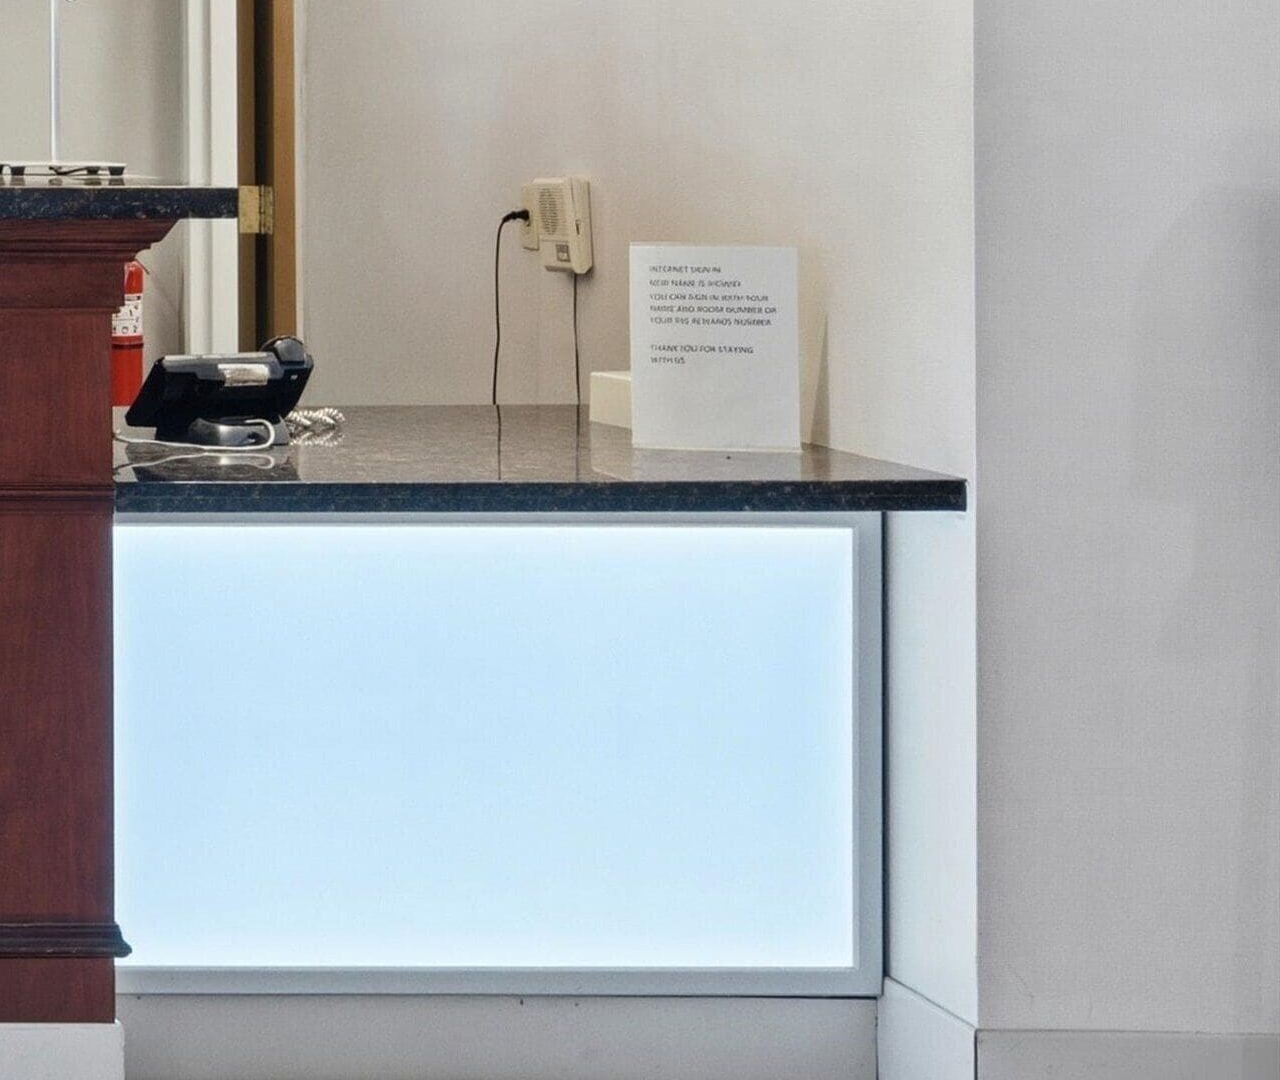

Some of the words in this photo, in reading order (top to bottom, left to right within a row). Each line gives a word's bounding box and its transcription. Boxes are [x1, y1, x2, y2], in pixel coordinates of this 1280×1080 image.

[649, 265, 688, 273] INTERNET
[649, 293, 668, 301] YOU
[668, 293, 687, 301] CAN
[725, 306, 763, 314] NUMBER
[650, 344, 679, 352] THANK
[699, 345, 716, 353] FOR
[718, 345, 754, 354] STAYING
